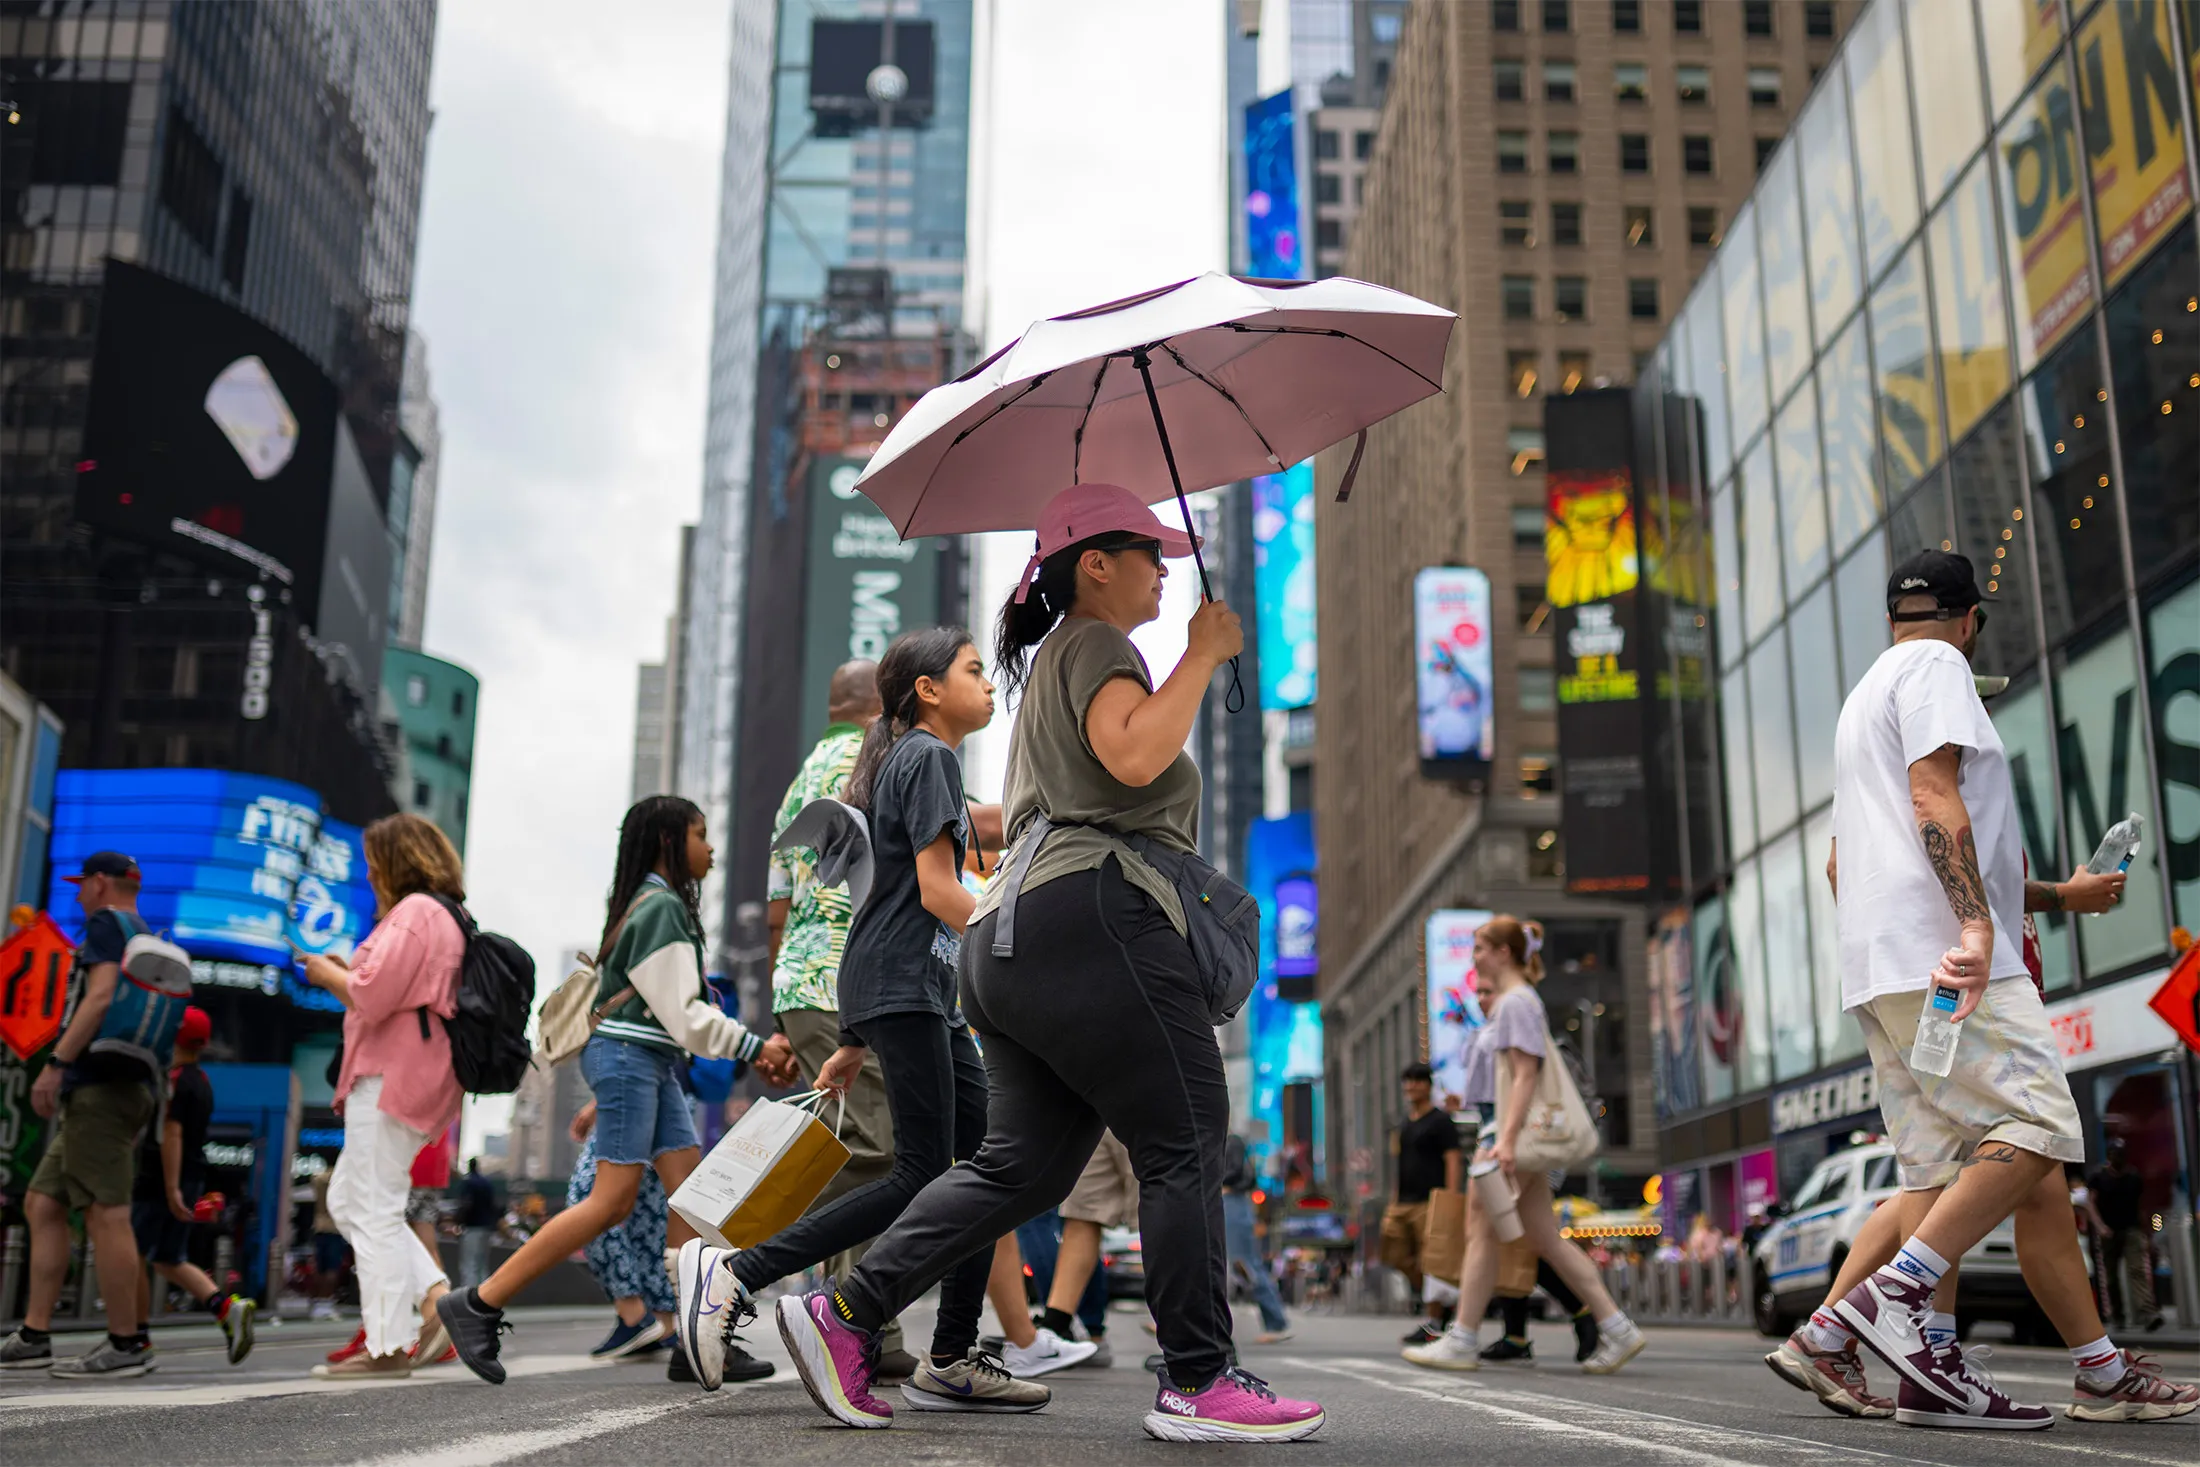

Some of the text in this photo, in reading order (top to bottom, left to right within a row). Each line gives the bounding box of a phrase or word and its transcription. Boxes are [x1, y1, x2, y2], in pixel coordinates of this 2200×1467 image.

[1938, 989, 1957, 999] ethos
[1773, 1066, 1878, 1134] SKECHE
[1903, 1260, 1924, 1275] NIKE
[1160, 1392, 1197, 1419] HOKA
